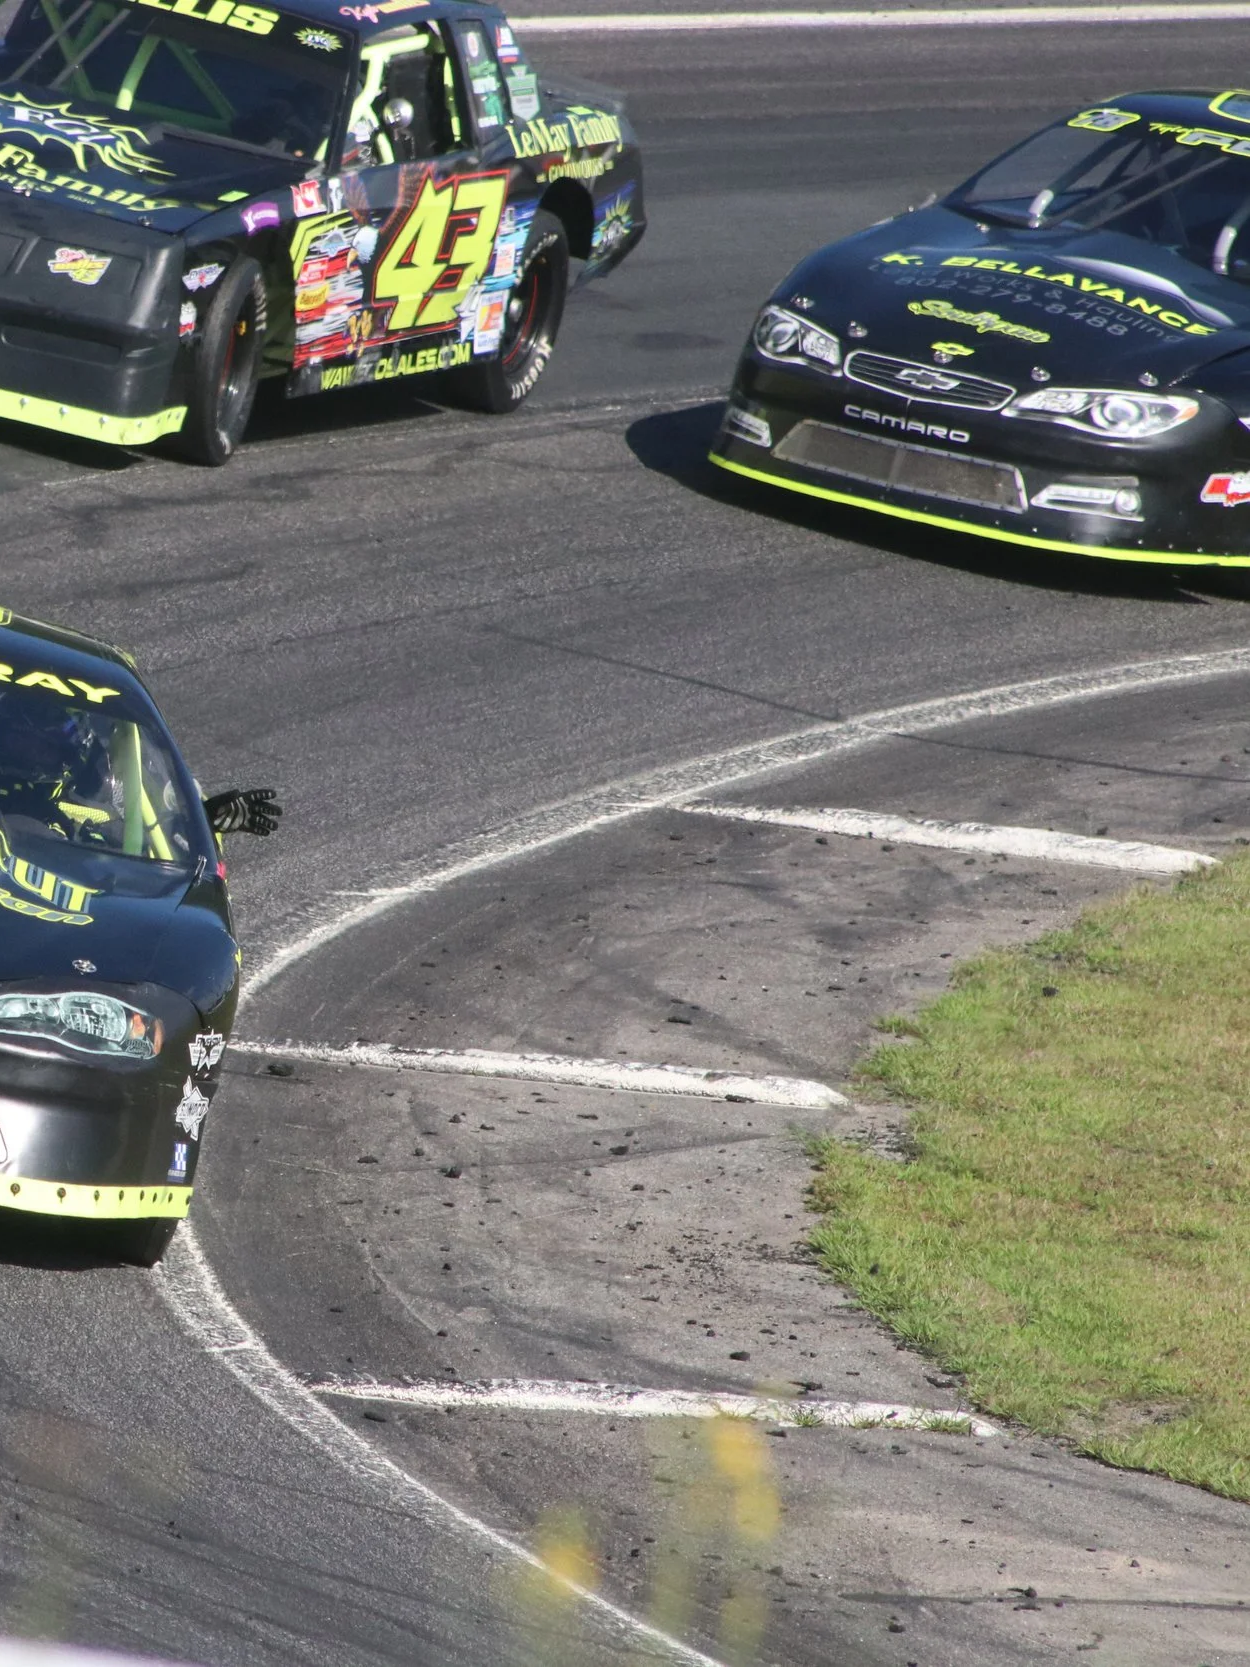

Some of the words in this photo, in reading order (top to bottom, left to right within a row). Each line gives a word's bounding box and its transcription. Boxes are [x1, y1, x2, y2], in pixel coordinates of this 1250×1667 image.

[126, 0, 281, 35] LIS
[506, 118, 573, 162] LeMay
[567, 108, 624, 153] Family
[371, 168, 511, 333] 43
[881, 253, 924, 266] K.
[940, 256, 1219, 336] BELLAVANCE
[894, 276, 1129, 336] 802-279-8488
[953, 269, 1036, 292] Works
[1044, 288, 1063, 300] &
[1075, 297, 1186, 343] Hauling
[844, 403, 970, 443] CAMARO
